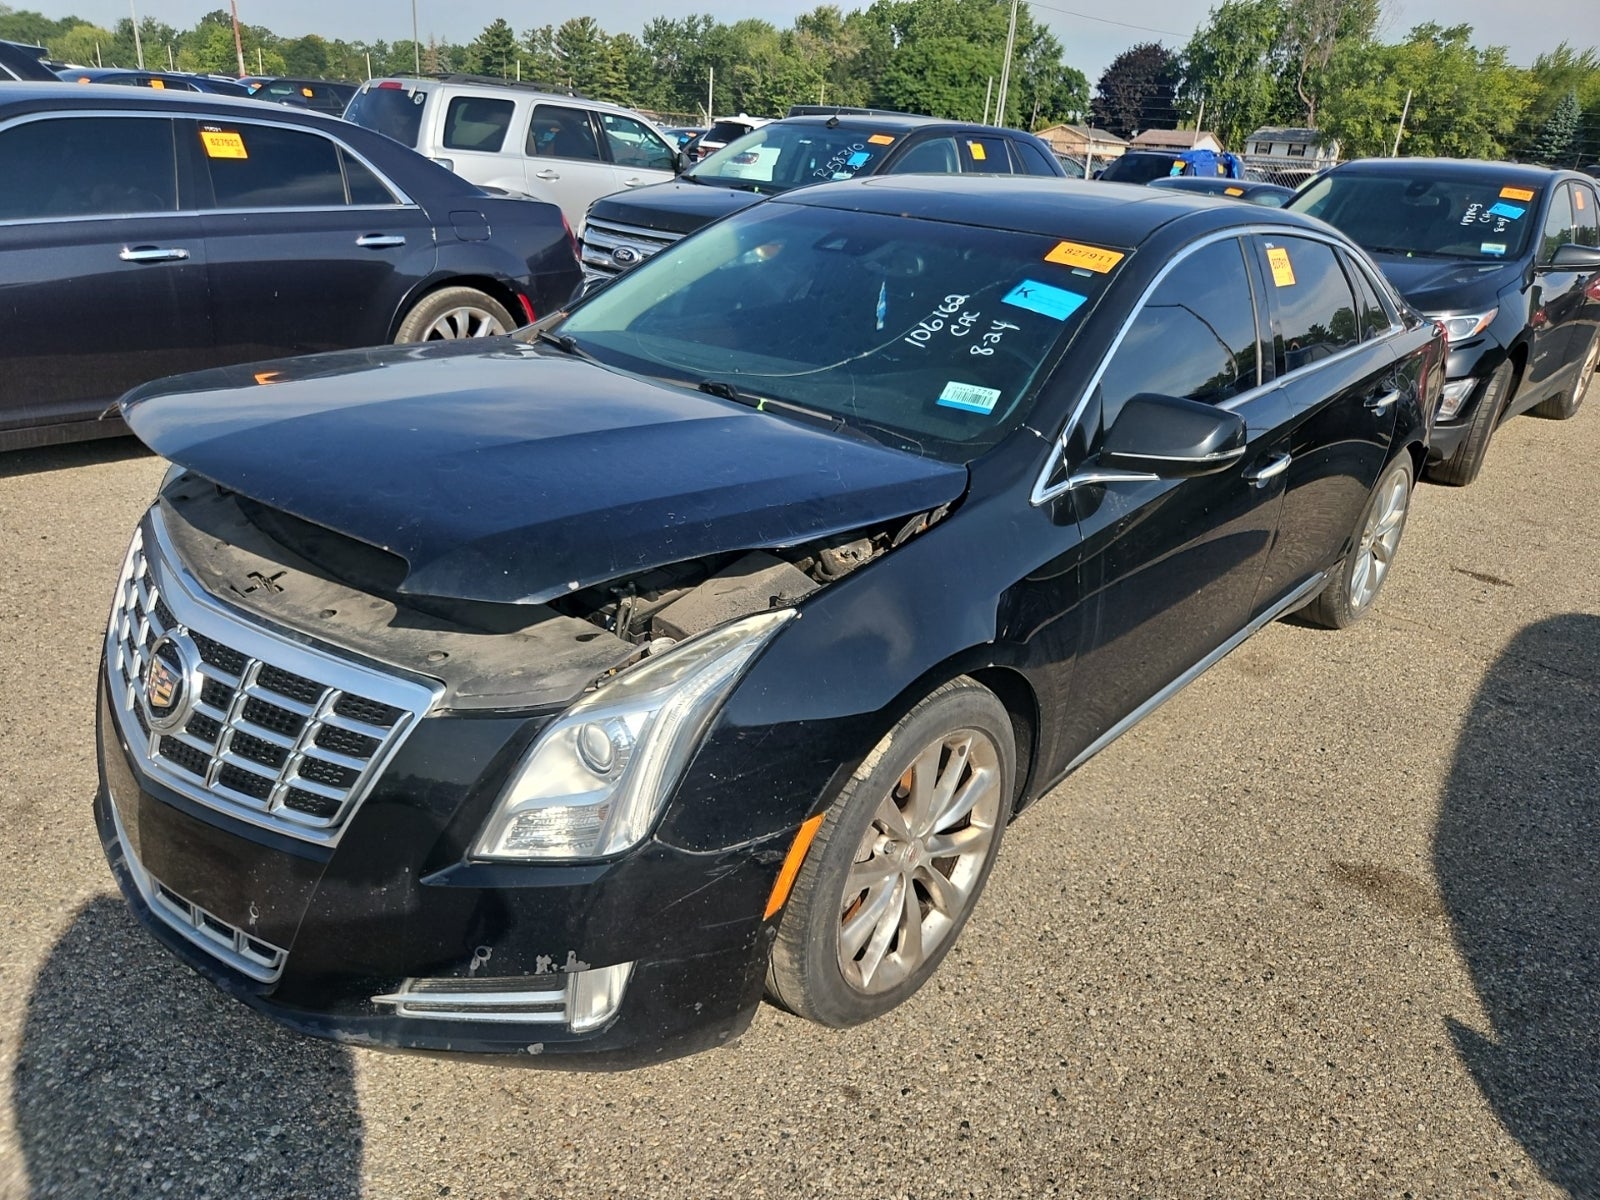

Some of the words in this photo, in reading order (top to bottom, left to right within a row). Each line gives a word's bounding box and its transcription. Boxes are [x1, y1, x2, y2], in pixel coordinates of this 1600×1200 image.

[210, 138, 240, 147] 827923
[1063, 247, 1113, 264] 827911
[1015, 287, 1036, 299] K
[904, 294, 971, 349] 106162
[950, 311, 981, 337] CAC
[970, 319, 1021, 356] 8-24
